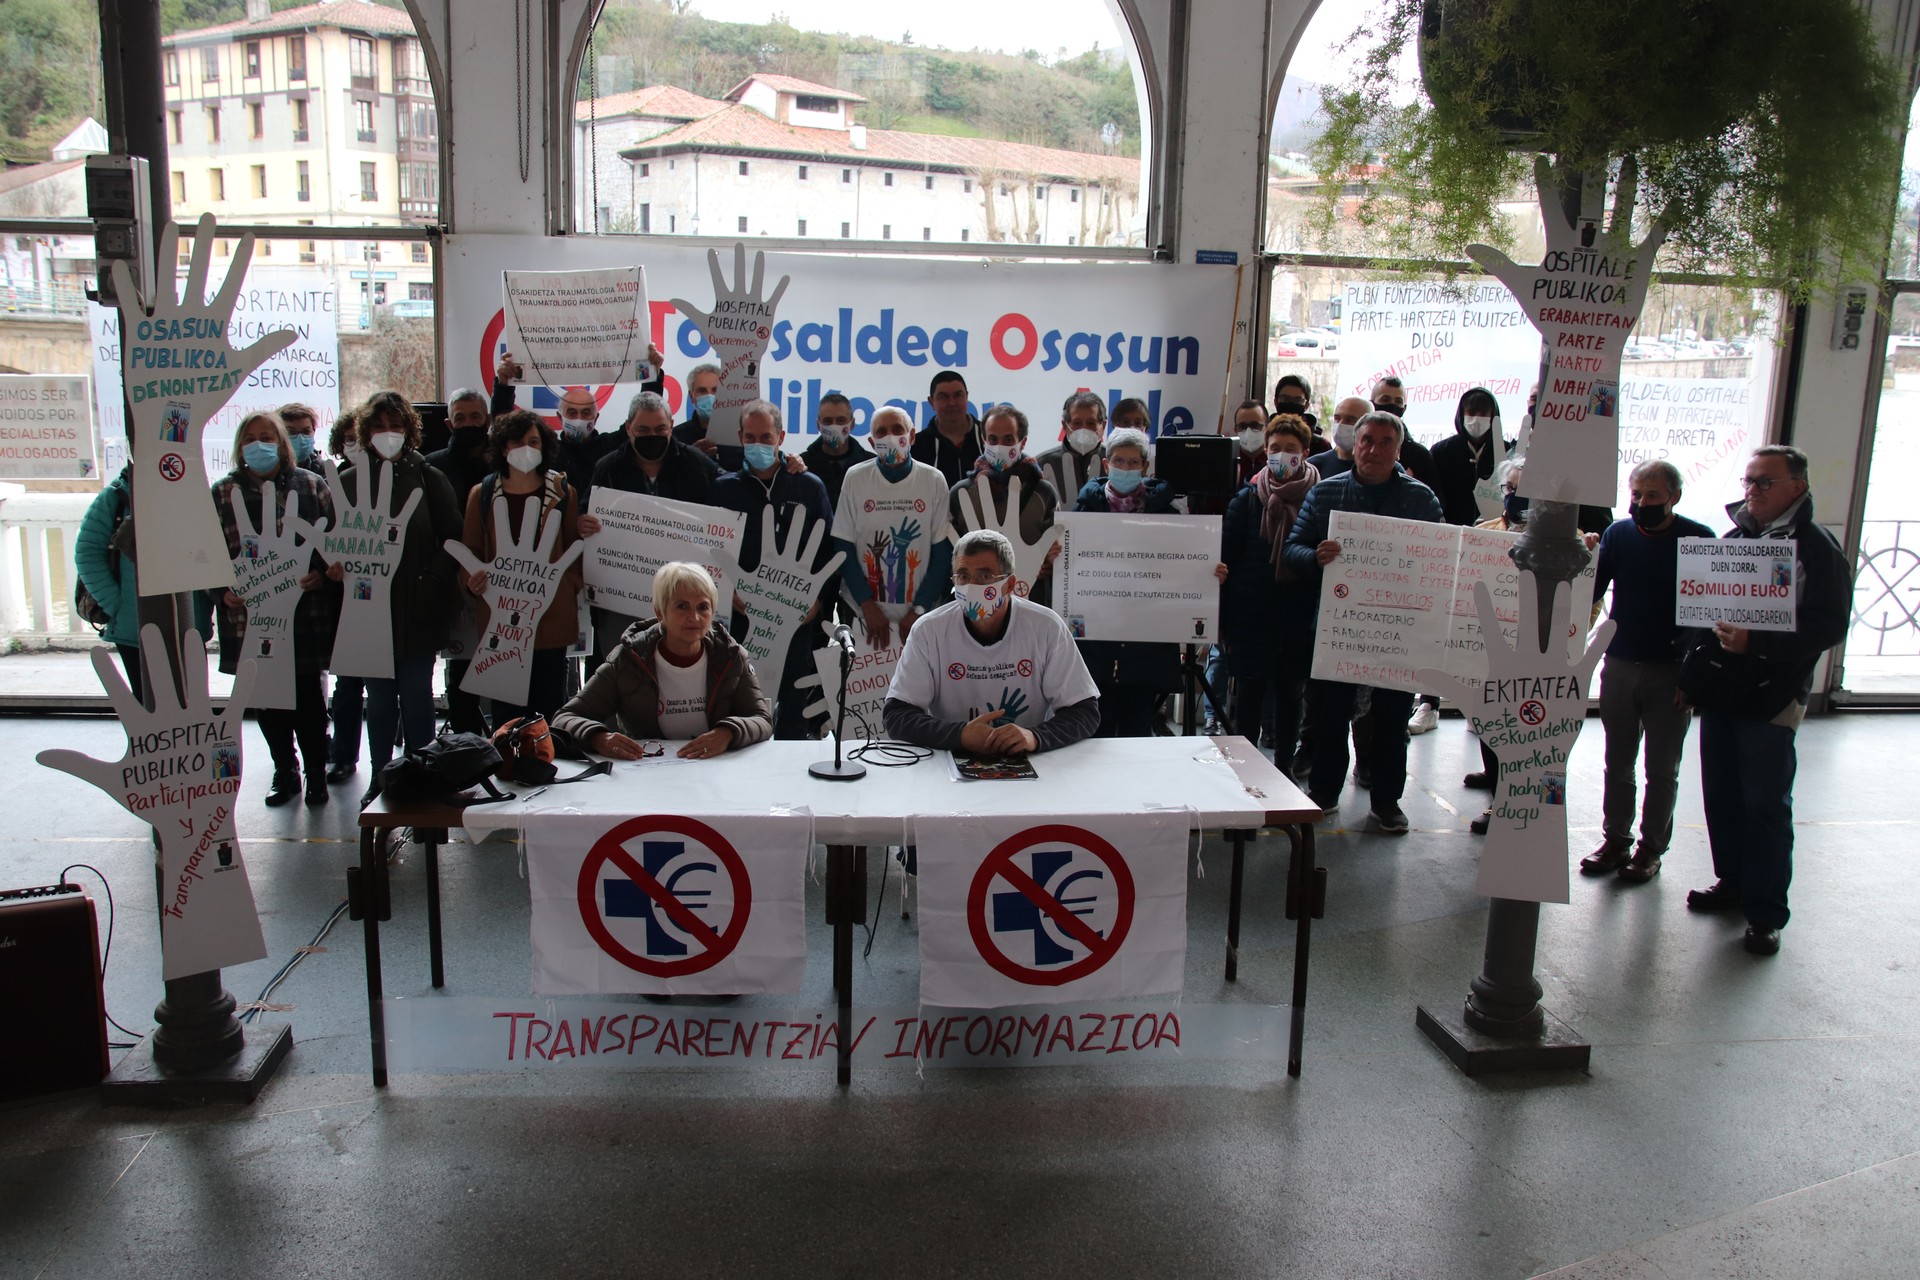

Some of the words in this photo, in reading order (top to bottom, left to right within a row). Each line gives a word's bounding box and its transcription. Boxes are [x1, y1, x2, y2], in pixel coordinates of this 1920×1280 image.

[1544, 250, 1638, 280] OSPITALE
[511, 288, 555, 297] OSAKIDETZA
[557, 286, 615, 296] TRAUMATOLOGIA
[616, 281, 639, 293] %100
[1532, 279, 1627, 305] PUBLIKOA
[519, 299, 577, 307] TRAUMATOLOGO
[579, 295, 634, 306] HOMOLOGATUAK
[715, 300, 772, 317] HOSPITAL
[557, 324, 616, 333] TRAUMATOLOGIA
[619, 319, 639, 330] %25
[708, 316, 757, 332] PUBLIKO
[1539, 307, 1635, 329] ERABAKIETAN
[137, 317, 224, 341] OSASUN
[521, 336, 579, 344] TRAUMATOLOGO
[580, 333, 638, 343] HOMOLOGATUAK
[708, 333, 758, 348] Queremos
[990, 313, 1199, 375] Osasun
[1411, 331, 1454, 349] DUGU
[1557, 332, 1605, 350] PARTE
[131, 347, 228, 369] PUBLIKOA
[531, 362, 566, 370] ZERBITZU
[567, 361, 601, 369] KALITATE
[1554, 356, 1603, 372] HARTU
[718, 351, 753, 386] participar
[133, 369, 243, 403] DENONTZAT
[248, 368, 336, 389] SERVICIOS
[727, 382, 739, 391] en
[1553, 378, 1592, 396] NAHI
[42, 389, 68, 400] SER
[49, 409, 75, 420] POR
[1542, 401, 1587, 422] DUGU
[1666, 428, 1716, 447] ARRETA
[342, 511, 383, 534] LAN
[595, 507, 640, 522] OSAKIDETZA
[707, 523, 735, 540] 100%
[1337, 515, 1357, 531] EL
[1365, 520, 1428, 538] HOSPITAL
[601, 519, 664, 537] TRAUMATÓLOGOS
[666, 531, 725, 549] HOMOLOGADOS
[324, 536, 385, 555] MAHAIA
[1406, 545, 1449, 558] MEDICOS
[1680, 544, 1724, 556] OSAKIDETZAK
[1726, 545, 1793, 557] TOLOSALDEAREKIN
[1187, 553, 1209, 561] DAGO
[1337, 553, 1390, 567] SERVICIO
[1399, 559, 1415, 569] DE
[1421, 561, 1483, 578] URGENCIAS
[345, 561, 390, 577] OSATU
[494, 556, 559, 581] OSPITALE
[1344, 569, 1409, 583] CONSULTAS
[1711, 561, 1729, 573] DUEN
[1731, 562, 1757, 573] ZORRA:
[486, 571, 546, 598] PUBLIKOA
[737, 578, 764, 597] Beste
[757, 564, 812, 595] EKITATEA
[245, 590, 270, 609] egon
[274, 575, 298, 593] nahi
[1133, 591, 1180, 599] EZKUTATZEN
[1182, 592, 1202, 600] DIGU
[1365, 588, 1434, 608] SERVICIOS
[1750, 584, 1789, 598] EURO
[1333, 608, 1415, 627] LABORATORIO
[1680, 606, 1702, 620] EKITATE
[1704, 607, 1722, 621] FALTA
[1724, 608, 1792, 625] TOLOSALDEAREKIN
[753, 624, 779, 641] nahi
[1332, 627, 1402, 641] RADIOLOGIA
[742, 637, 770, 661] dugu
[966, 671, 988, 680] defenda
[988, 663, 1015, 673] publikoa
[1484, 675, 1580, 704] EKITATEA
[1472, 708, 1518, 736] Beste
[130, 721, 232, 758] HOSPITAL
[1489, 717, 1583, 748] eskualdekin
[123, 752, 205, 788] PUBLIKO
[1500, 745, 1566, 781] parekatu
[126, 778, 241, 813] Participacion
[1509, 777, 1543, 797] nahi
[1496, 801, 1539, 830] dugu
[164, 805, 229, 919] Transparencia
[885, 1012, 1180, 1058] INFORMAZIOA
